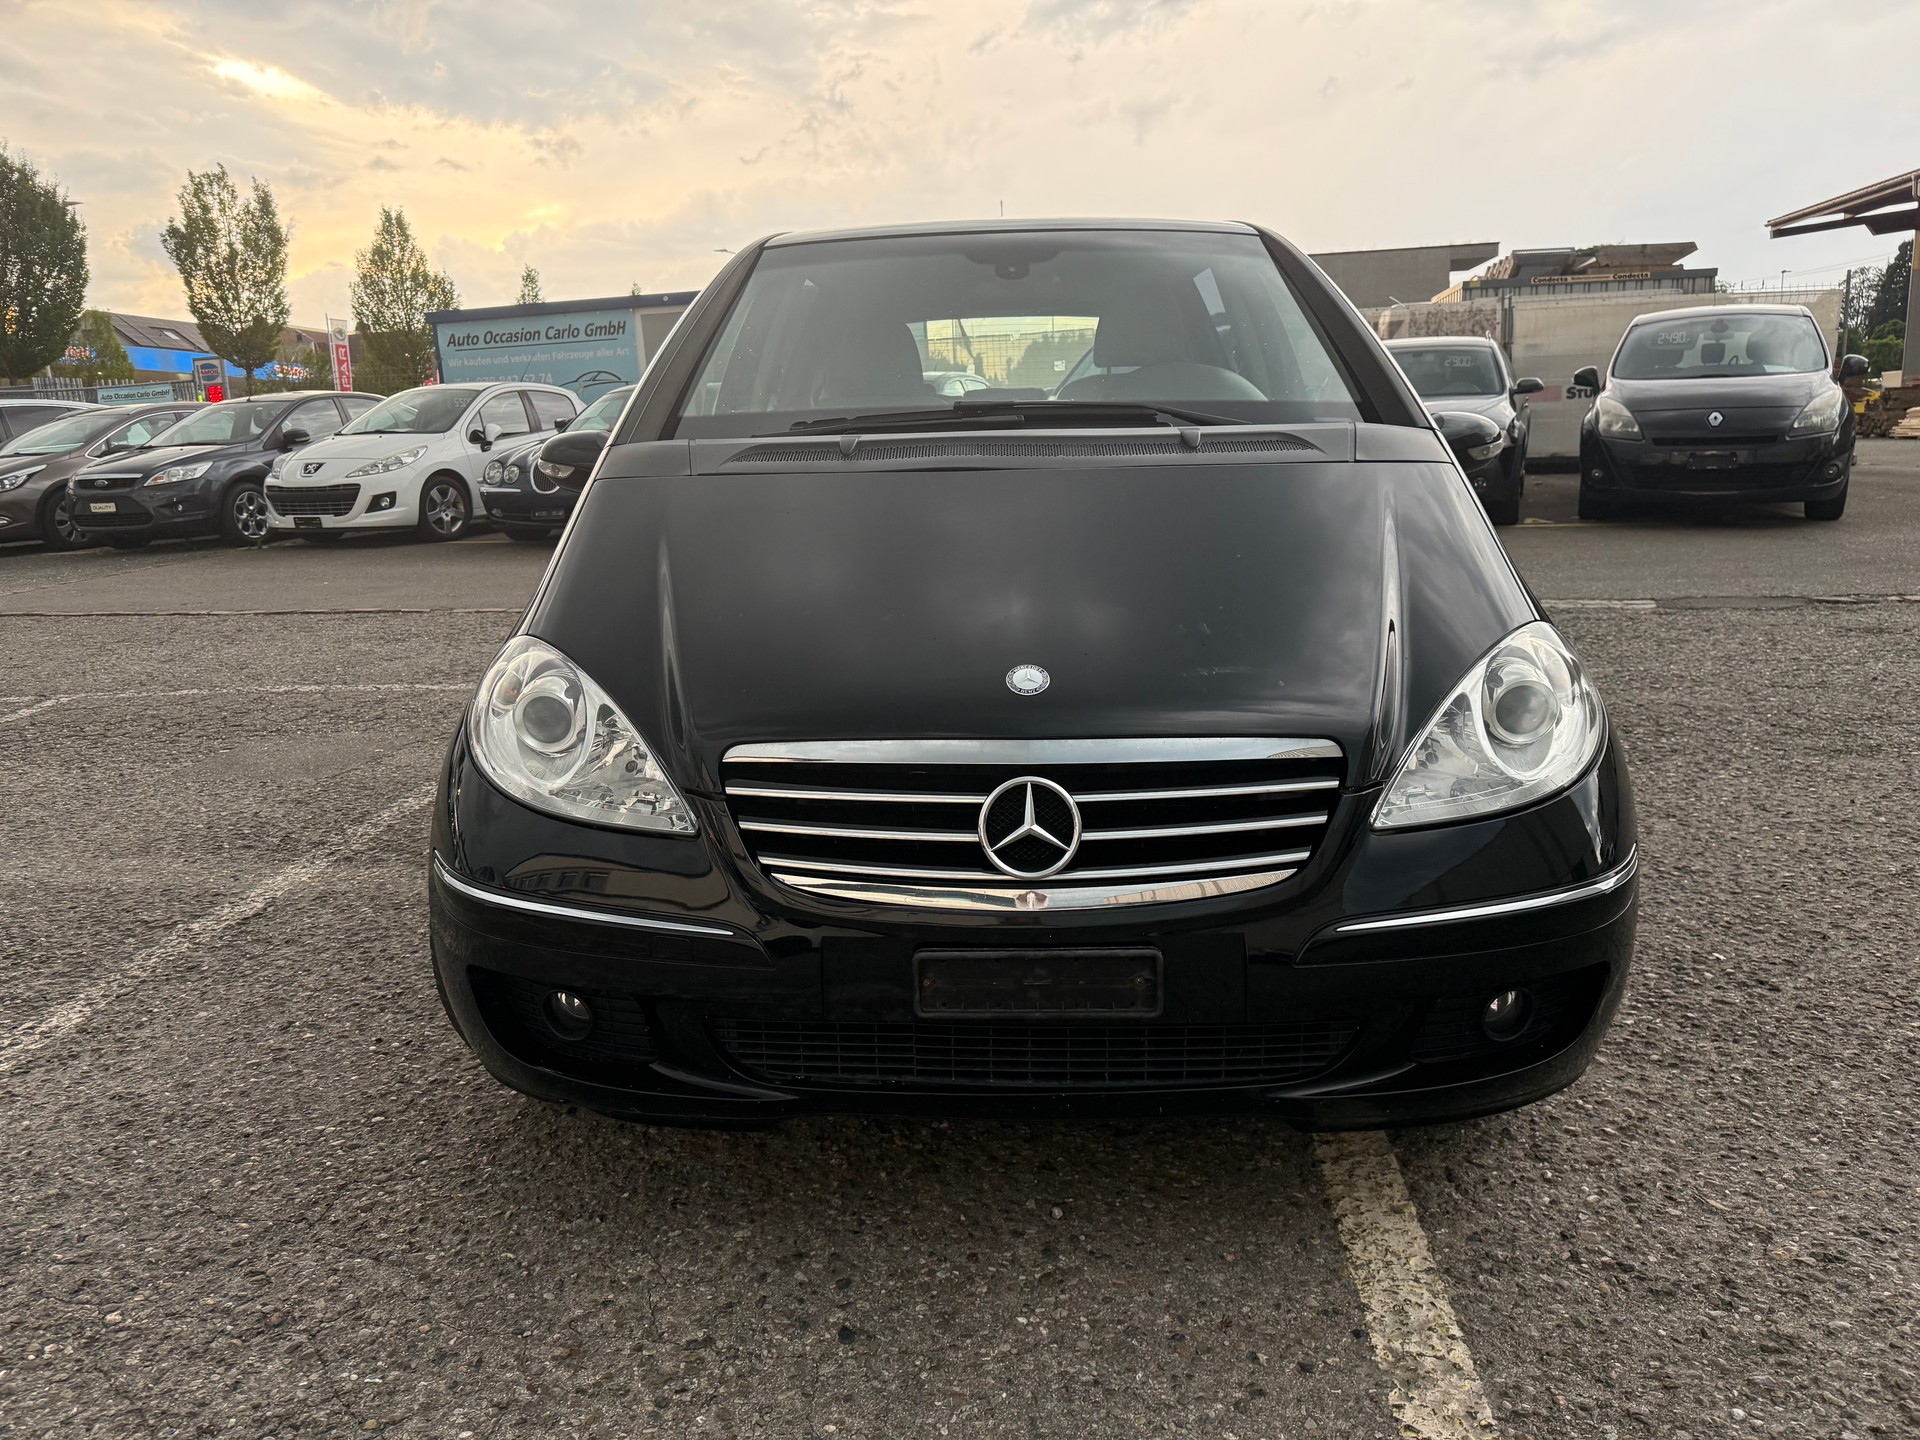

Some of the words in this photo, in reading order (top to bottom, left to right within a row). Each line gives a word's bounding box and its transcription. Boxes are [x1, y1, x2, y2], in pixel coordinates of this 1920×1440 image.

[1612, 272, 1649, 280] Condecta
[446, 333, 480, 348] Auto
[483, 327, 541, 345] Occasion
[544, 323, 580, 340] Carlo
[584, 320, 627, 337] GmbH
[448, 357, 463, 367] Wir
[464, 356, 492, 367] kaufen
[493, 354, 509, 365] und
[552, 350, 594, 360] Fahrzeuge
[596, 347, 614, 357] aller
[616, 347, 630, 356] Art
[338, 347, 351, 392] PAR
[114, 391, 136, 399] Occasion
[136, 390, 150, 398] Carlo
[151, 389, 170, 397] GmbH
